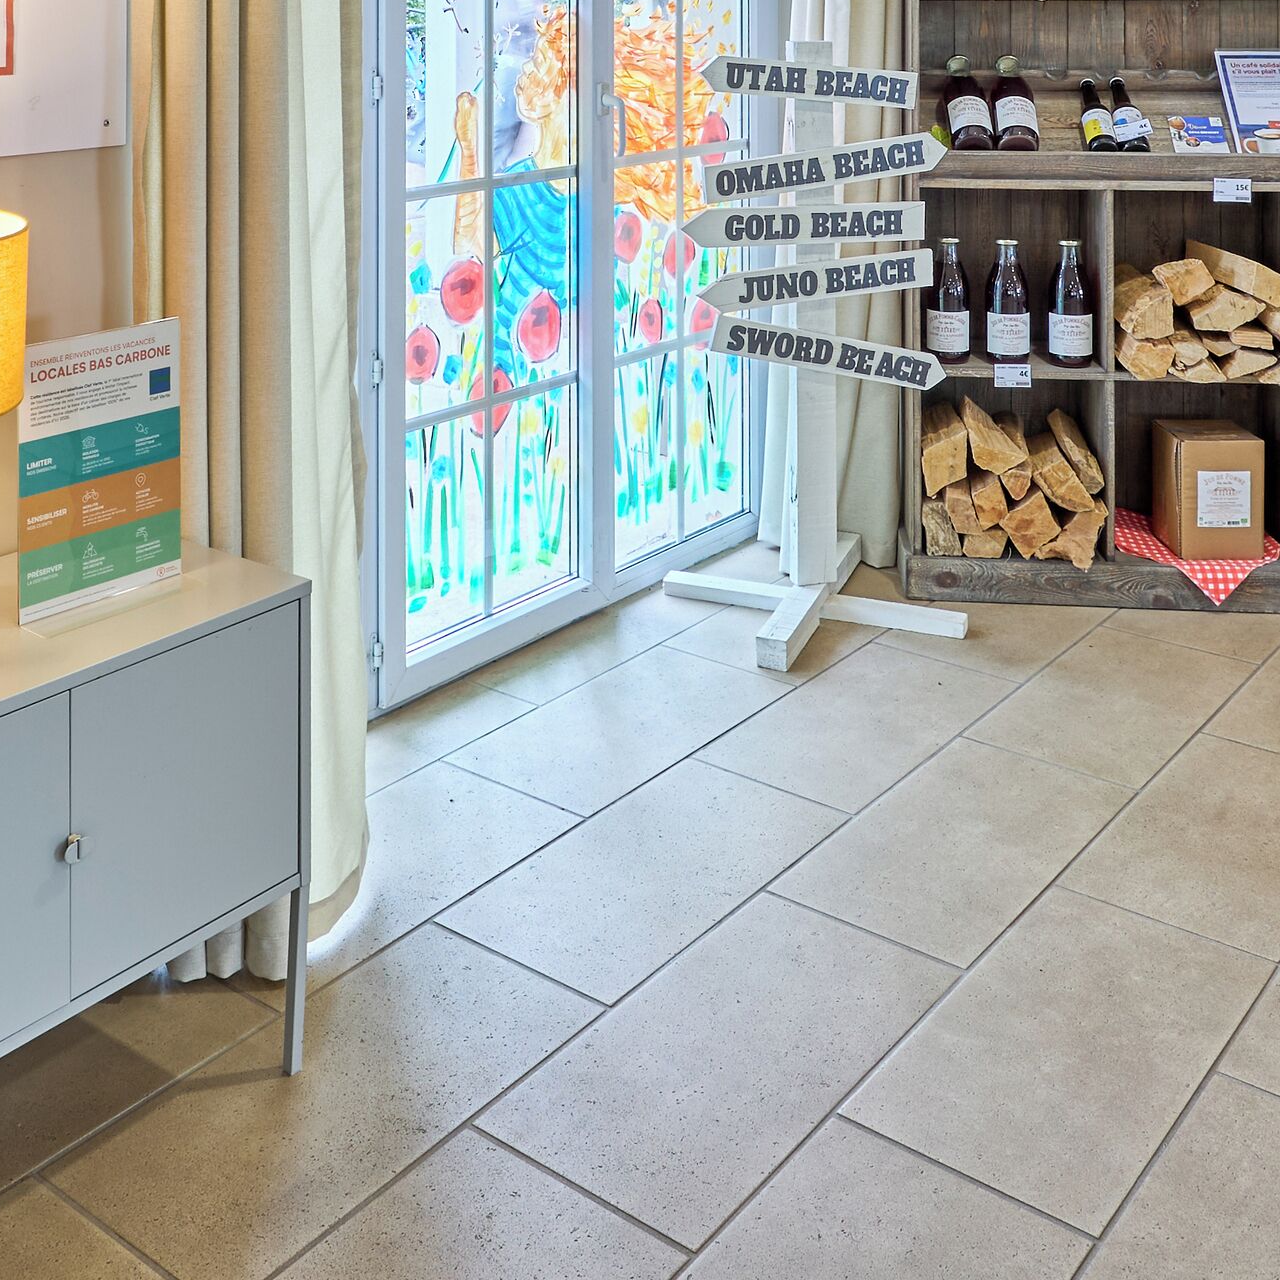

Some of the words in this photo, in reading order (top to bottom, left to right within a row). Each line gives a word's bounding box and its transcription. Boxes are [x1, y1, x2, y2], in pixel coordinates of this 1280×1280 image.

[726, 62, 807, 93] UTAH
[815, 70, 910, 105] BEACH
[715, 157, 826, 196] OMAHA
[832, 140, 925, 180] BEACH
[1235, 184, 1249, 192] 15€
[725, 214, 801, 241] GOLD
[811, 209, 903, 238] BEACH
[738, 270, 819, 304] JUNO
[824, 257, 917, 294] BEACH
[30, 355, 63, 368] ENSEMBLE
[110, 343, 121, 351] LES
[122, 337, 156, 349] VACANCES
[30, 362, 86, 384] LOCALES
[89, 357, 112, 371] BAS
[115, 345, 171, 365] CARBONE
[727, 324, 834, 366] SWORD
[837, 343, 932, 388] BEACH
[26, 457, 53, 470] LIMITER
[27, 508, 68, 525] SENSIBILISER
[27, 563, 63, 580] PRÉSERVER
